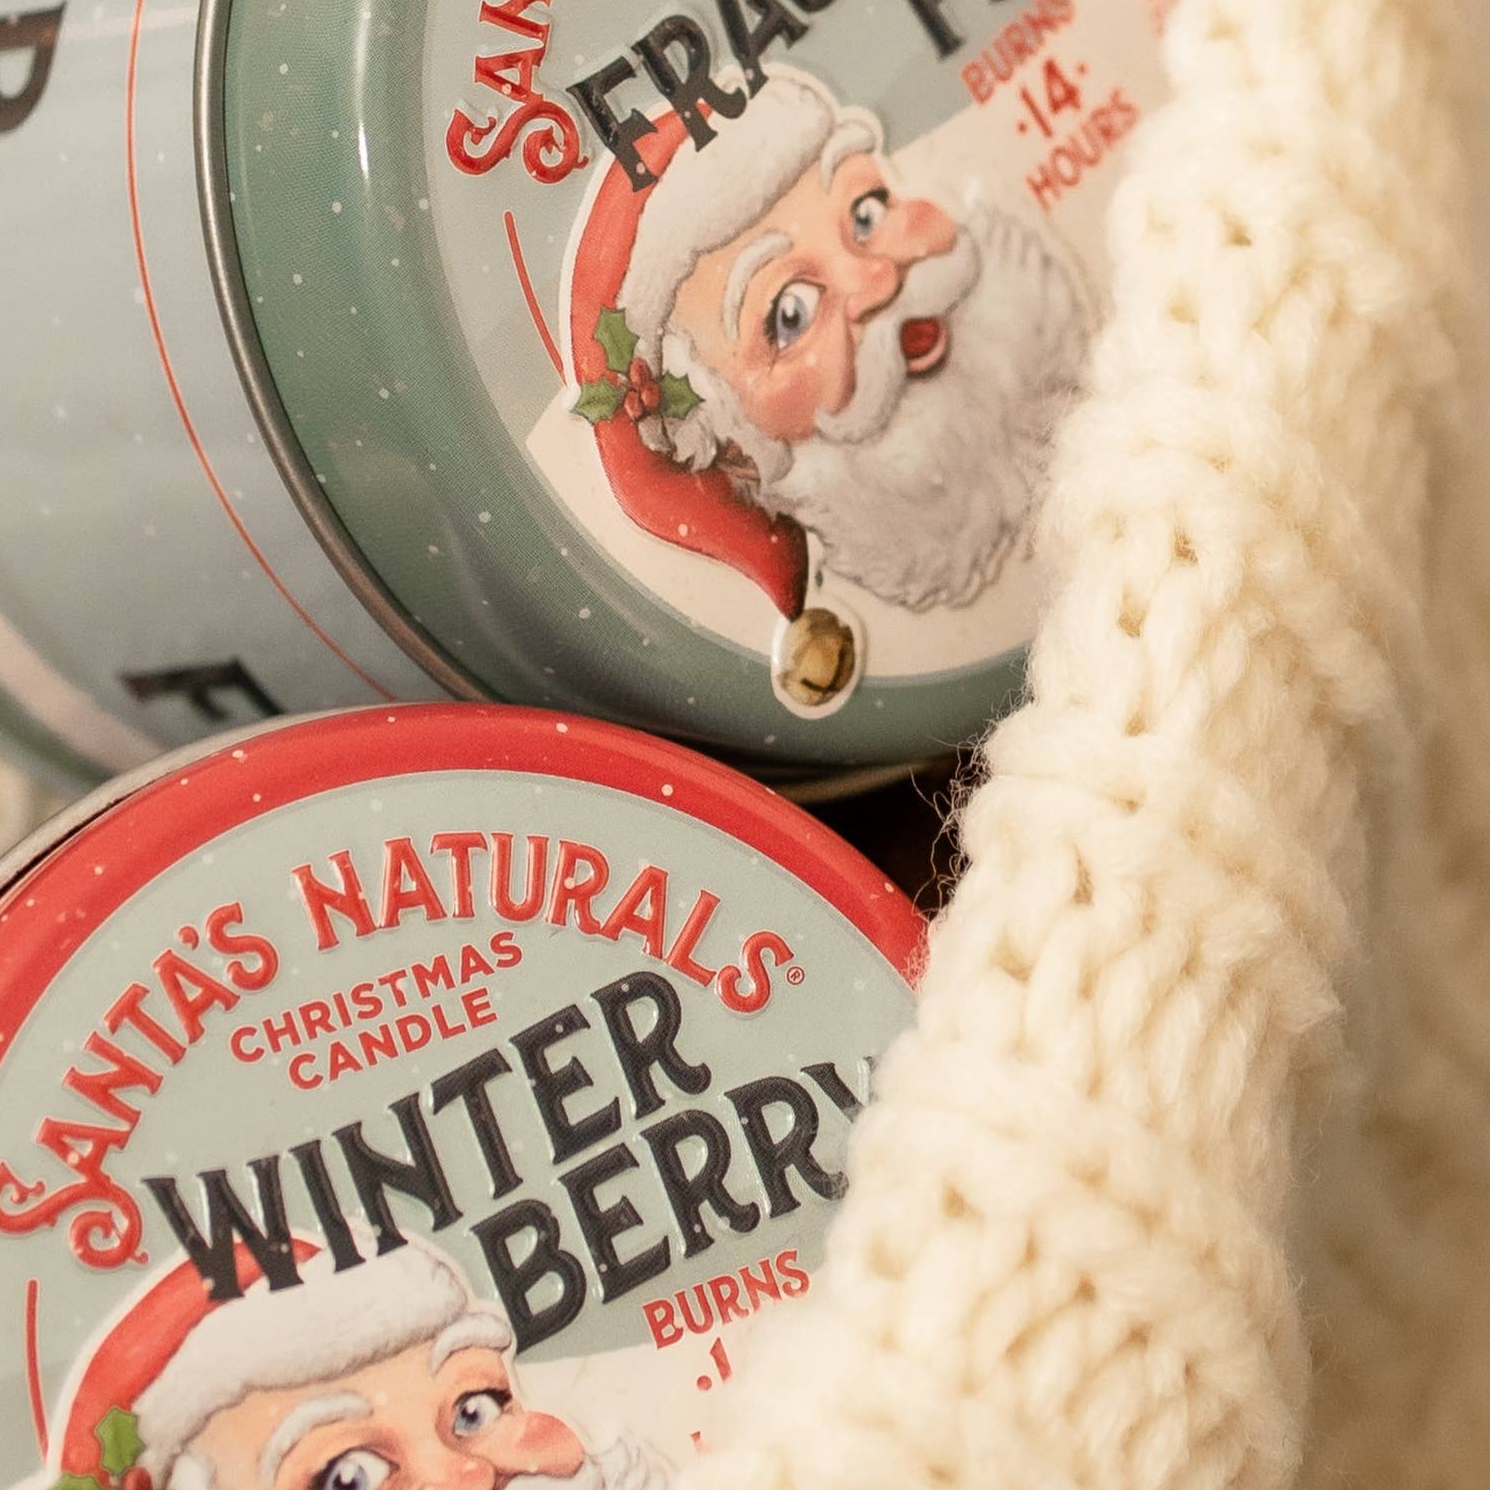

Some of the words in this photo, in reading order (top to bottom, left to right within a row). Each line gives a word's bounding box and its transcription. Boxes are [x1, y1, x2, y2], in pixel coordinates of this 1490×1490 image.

[1024, 87, 1141, 213] HOURS
[229, 930, 525, 1066] CHRISTMAS
[287, 987, 500, 1092] CANDLE
[142, 970, 712, 1305] WINTER
[641, 1249, 812, 1351] BURNS
